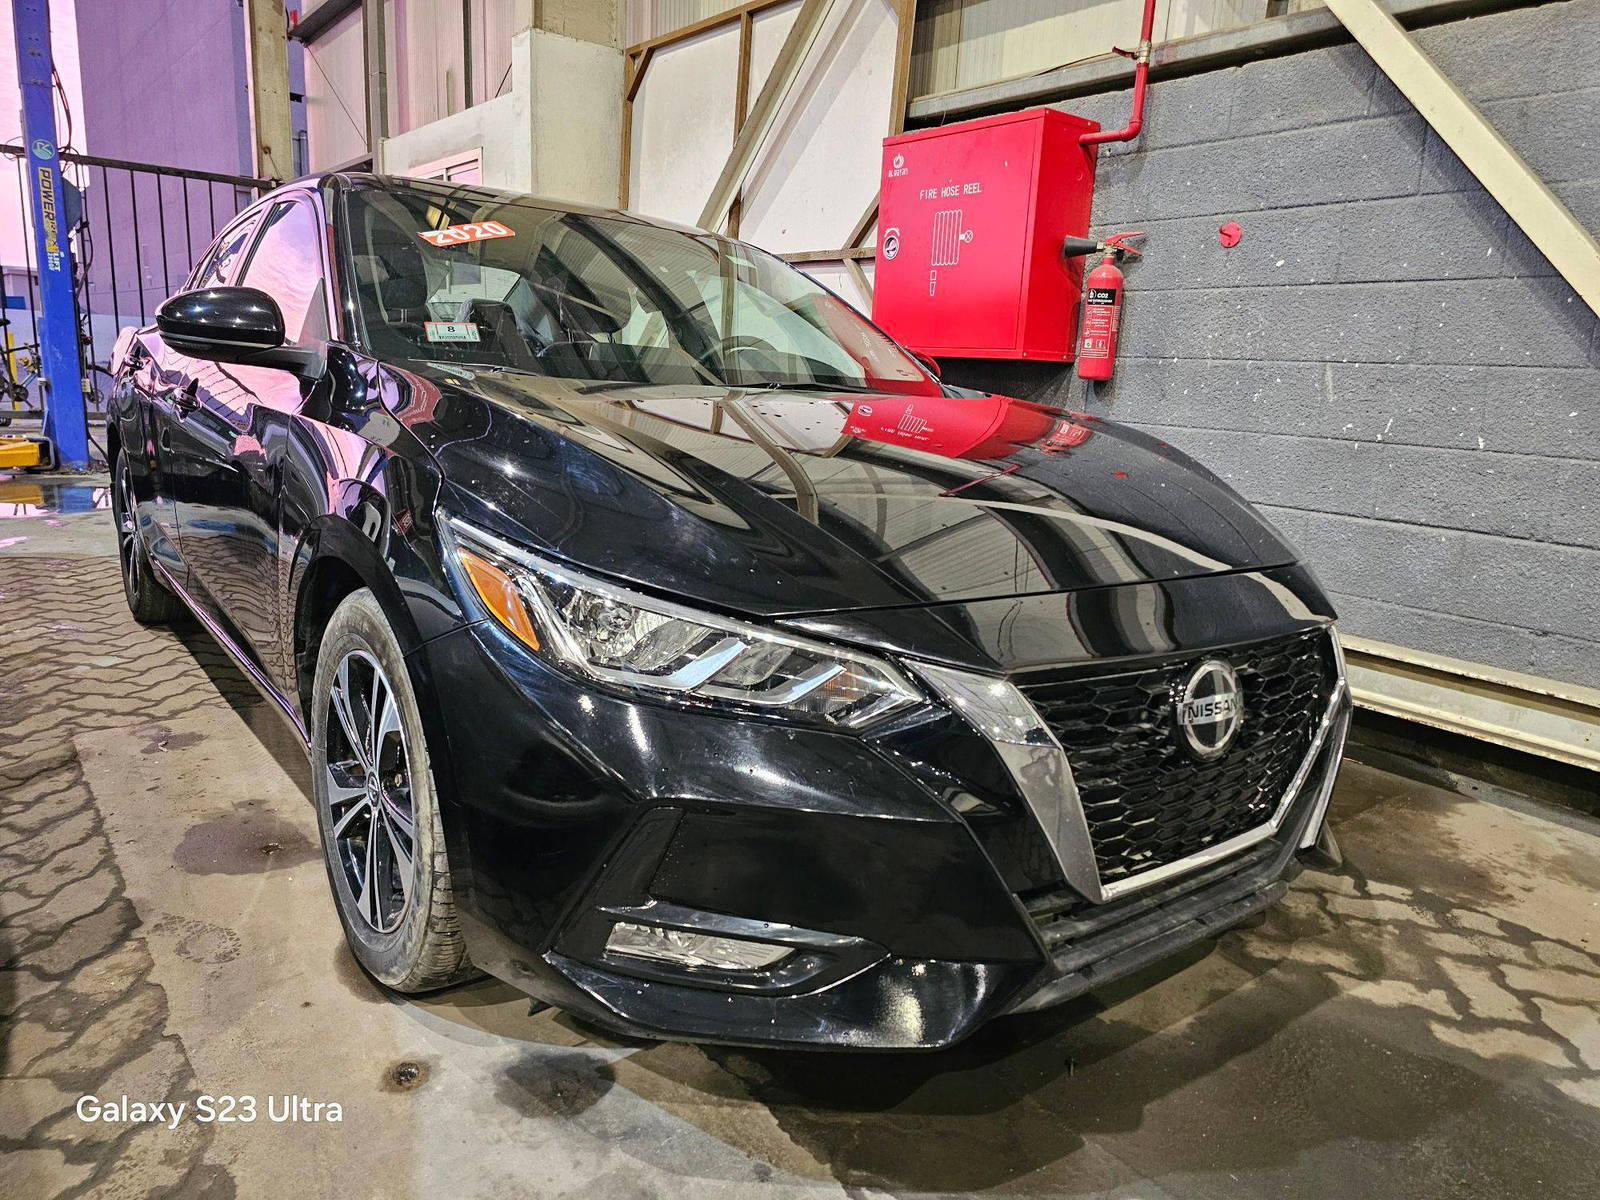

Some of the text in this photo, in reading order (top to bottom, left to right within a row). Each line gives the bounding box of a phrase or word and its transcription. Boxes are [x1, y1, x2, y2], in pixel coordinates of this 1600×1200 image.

[920, 182, 982, 200] FIRE HOSE REEL
[434, 222, 508, 244] 2020
[1188, 697, 1239, 721] NISSAN
